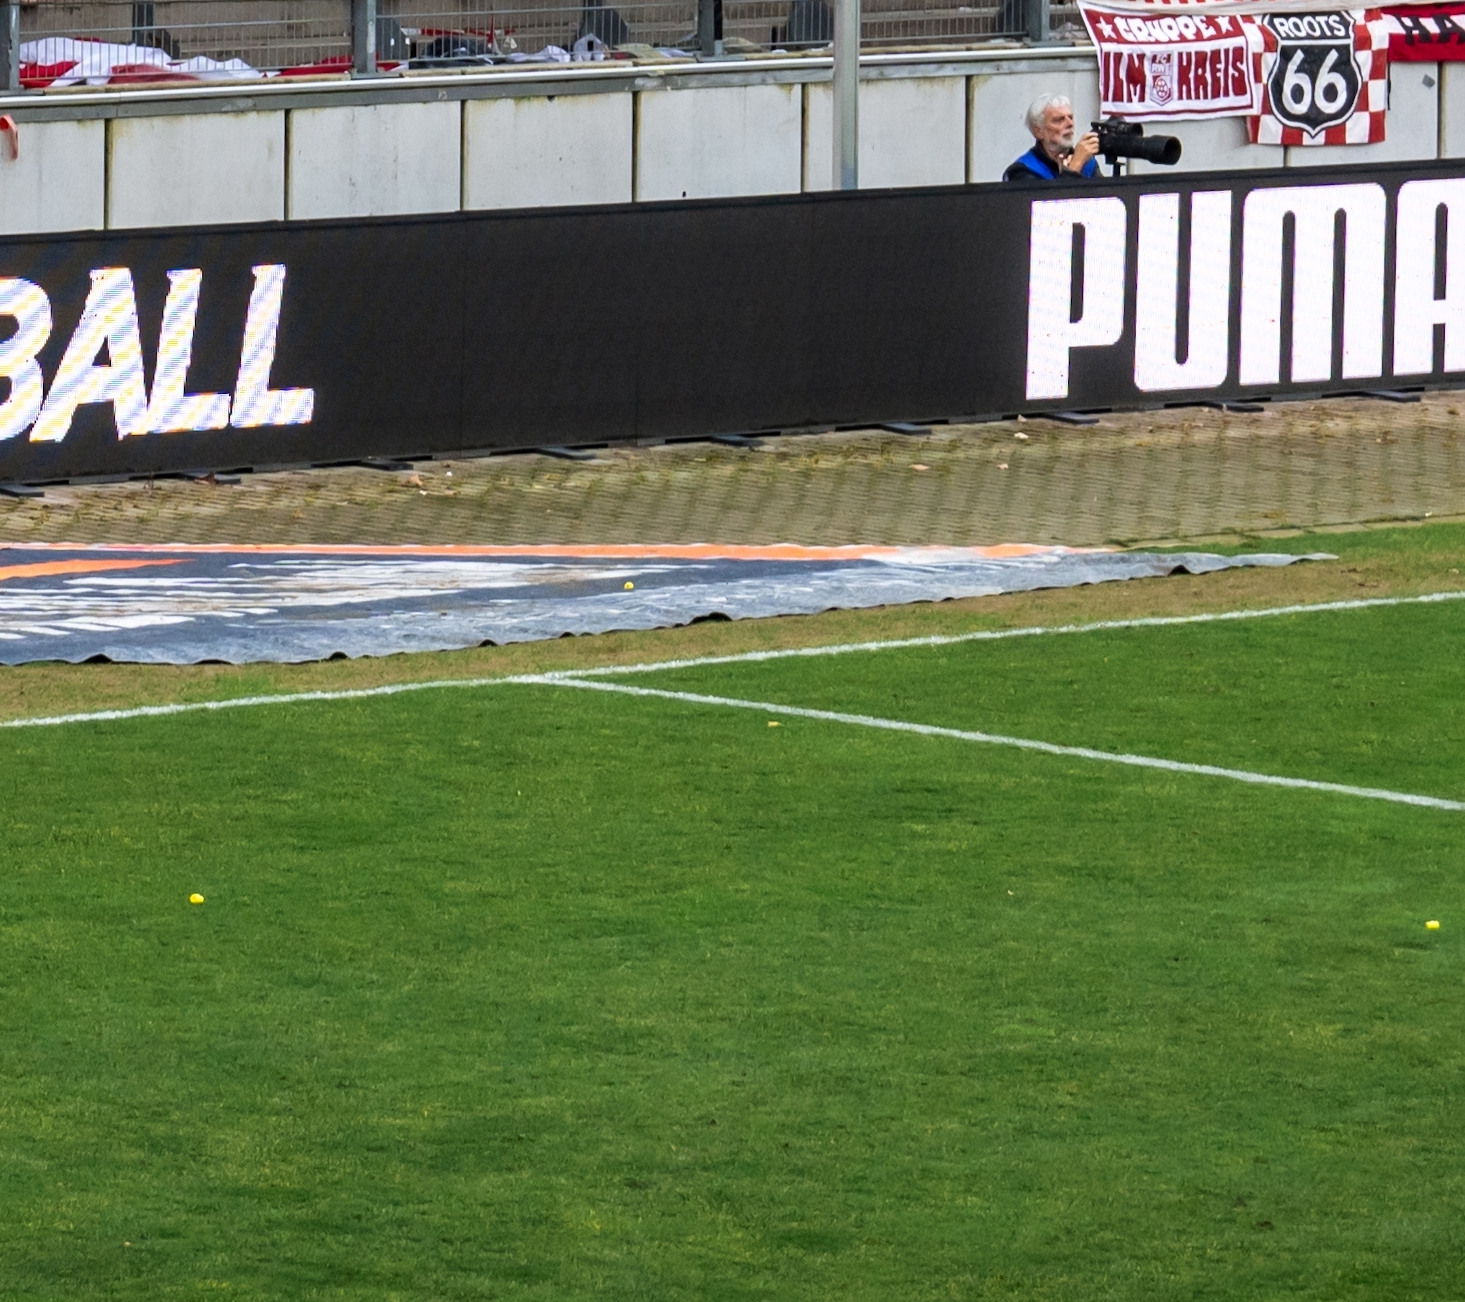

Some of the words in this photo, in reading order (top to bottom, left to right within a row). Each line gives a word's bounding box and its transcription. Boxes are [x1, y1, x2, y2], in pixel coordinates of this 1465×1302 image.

[1113, 14, 1216, 43] GRUPPE
[1273, 14, 1345, 39] ROOTS
[1103, 51, 1147, 104] ILM
[1176, 46, 1248, 101] KREIS
[1282, 47, 1348, 116] 66
